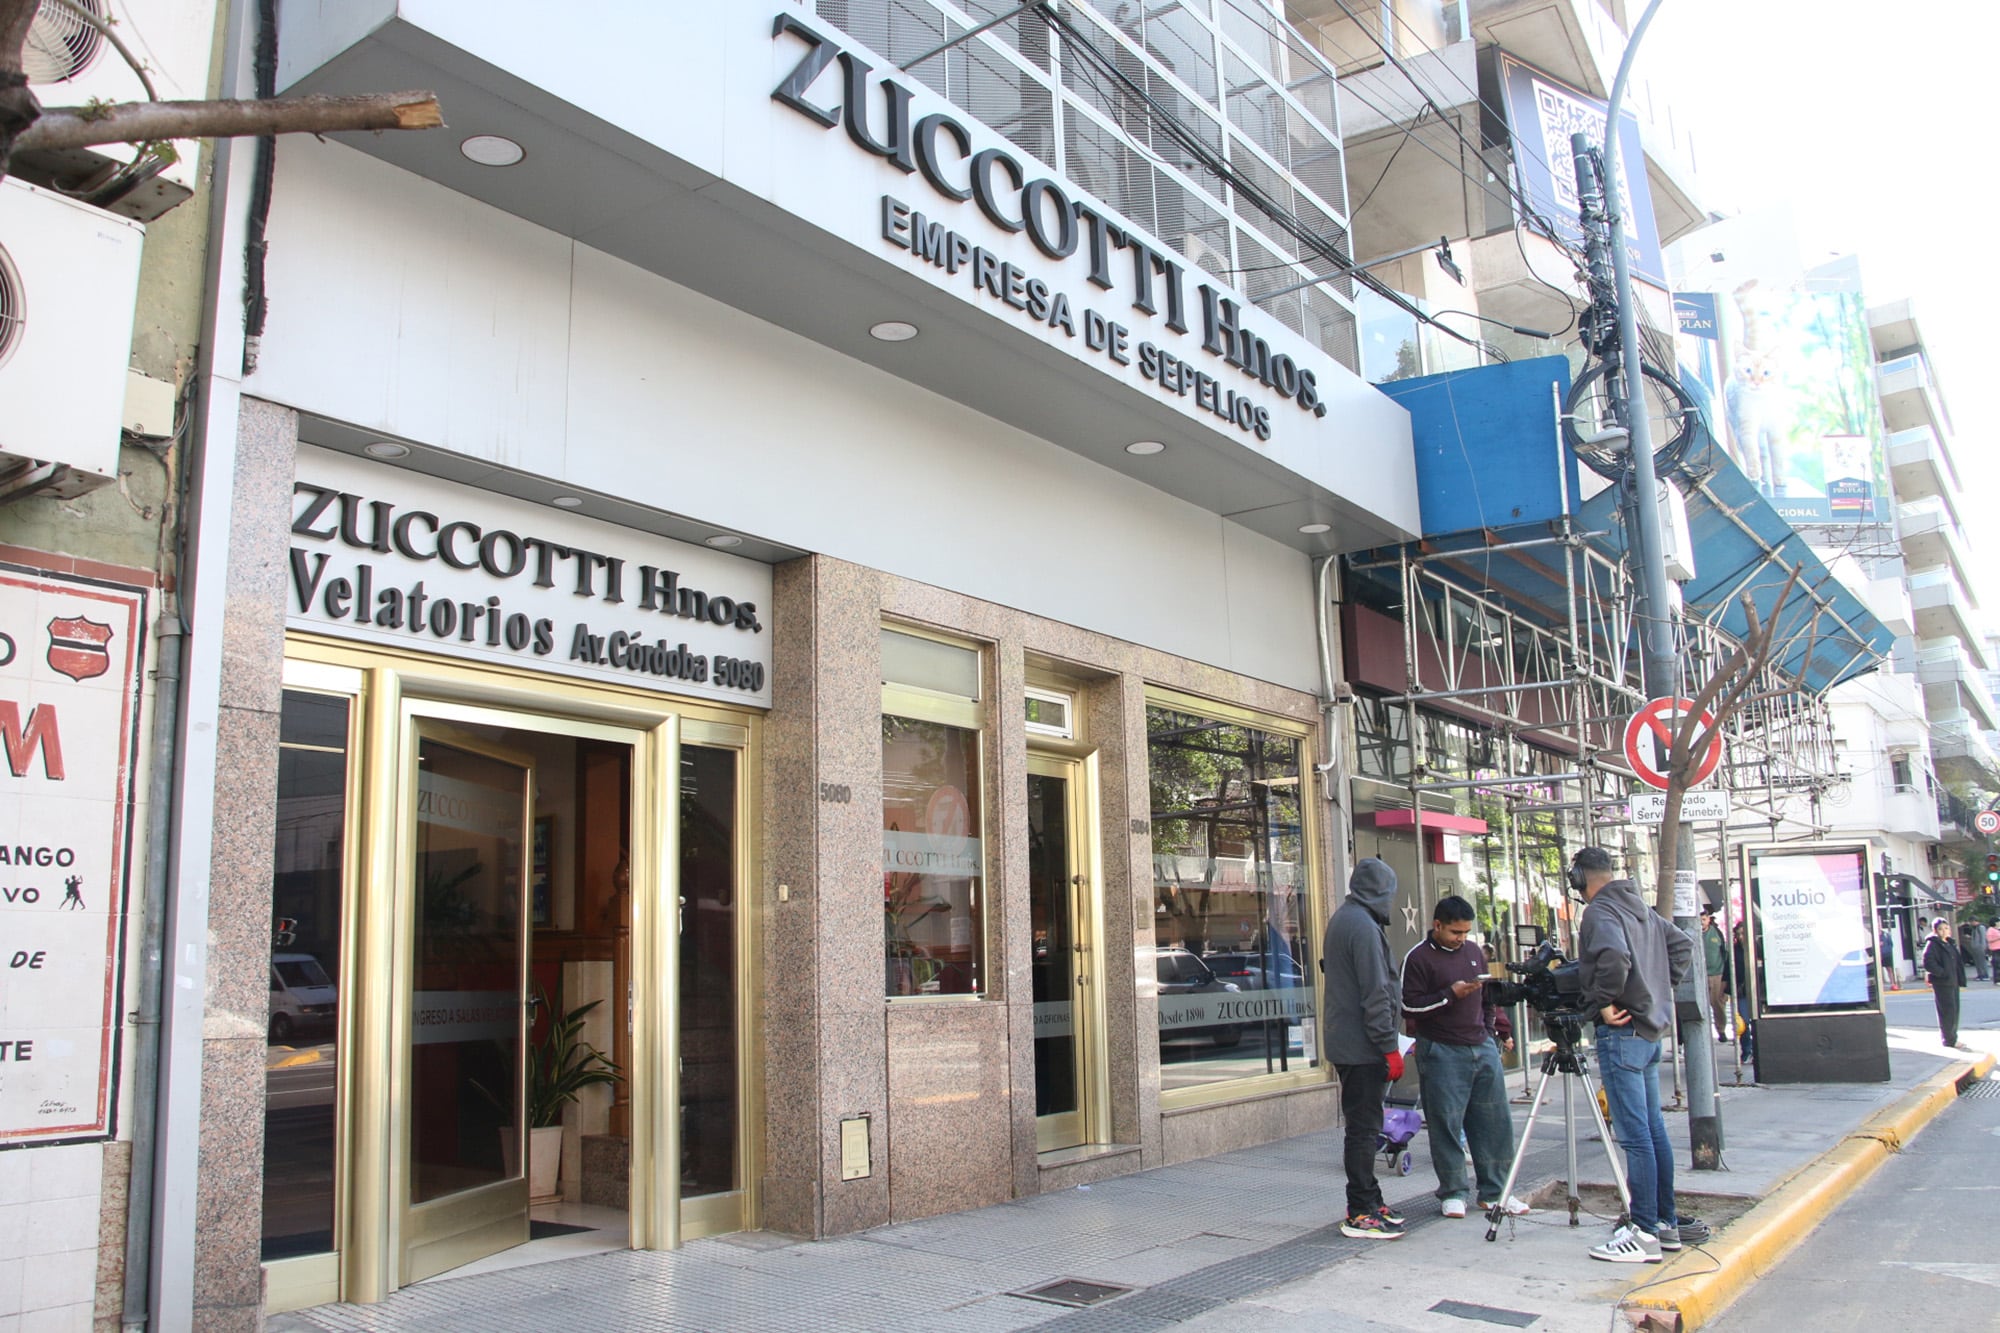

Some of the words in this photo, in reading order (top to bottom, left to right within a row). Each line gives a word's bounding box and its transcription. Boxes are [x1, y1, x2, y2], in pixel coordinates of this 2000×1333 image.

[770, 12, 1188, 336] ZUCCOTTI
[1198, 283, 1327, 418] Hnos.
[881, 194, 1076, 340] EMPRESA
[1084, 308, 1131, 367] DE
[1138, 327, 1272, 442] SEPELIOS
[1680, 319, 1712, 329] PLAN
[291, 481, 626, 604] ZUCCOTTI
[637, 565, 763, 633] Hnos.
[289, 547, 554, 656] Velatorios
[714, 655, 764, 692] 5080
[820, 782, 851, 805] 5080
[1652, 795, 1706, 807] Revado
[1980, 817, 1995, 827] 50
[3, 887, 40, 904] VO
[1770, 888, 1826, 907] xubio
[9, 950, 46, 969] DE
[1185, 1007, 1205, 1023] 1890
[1217, 999, 1284, 1020] ZUCCOTTI
